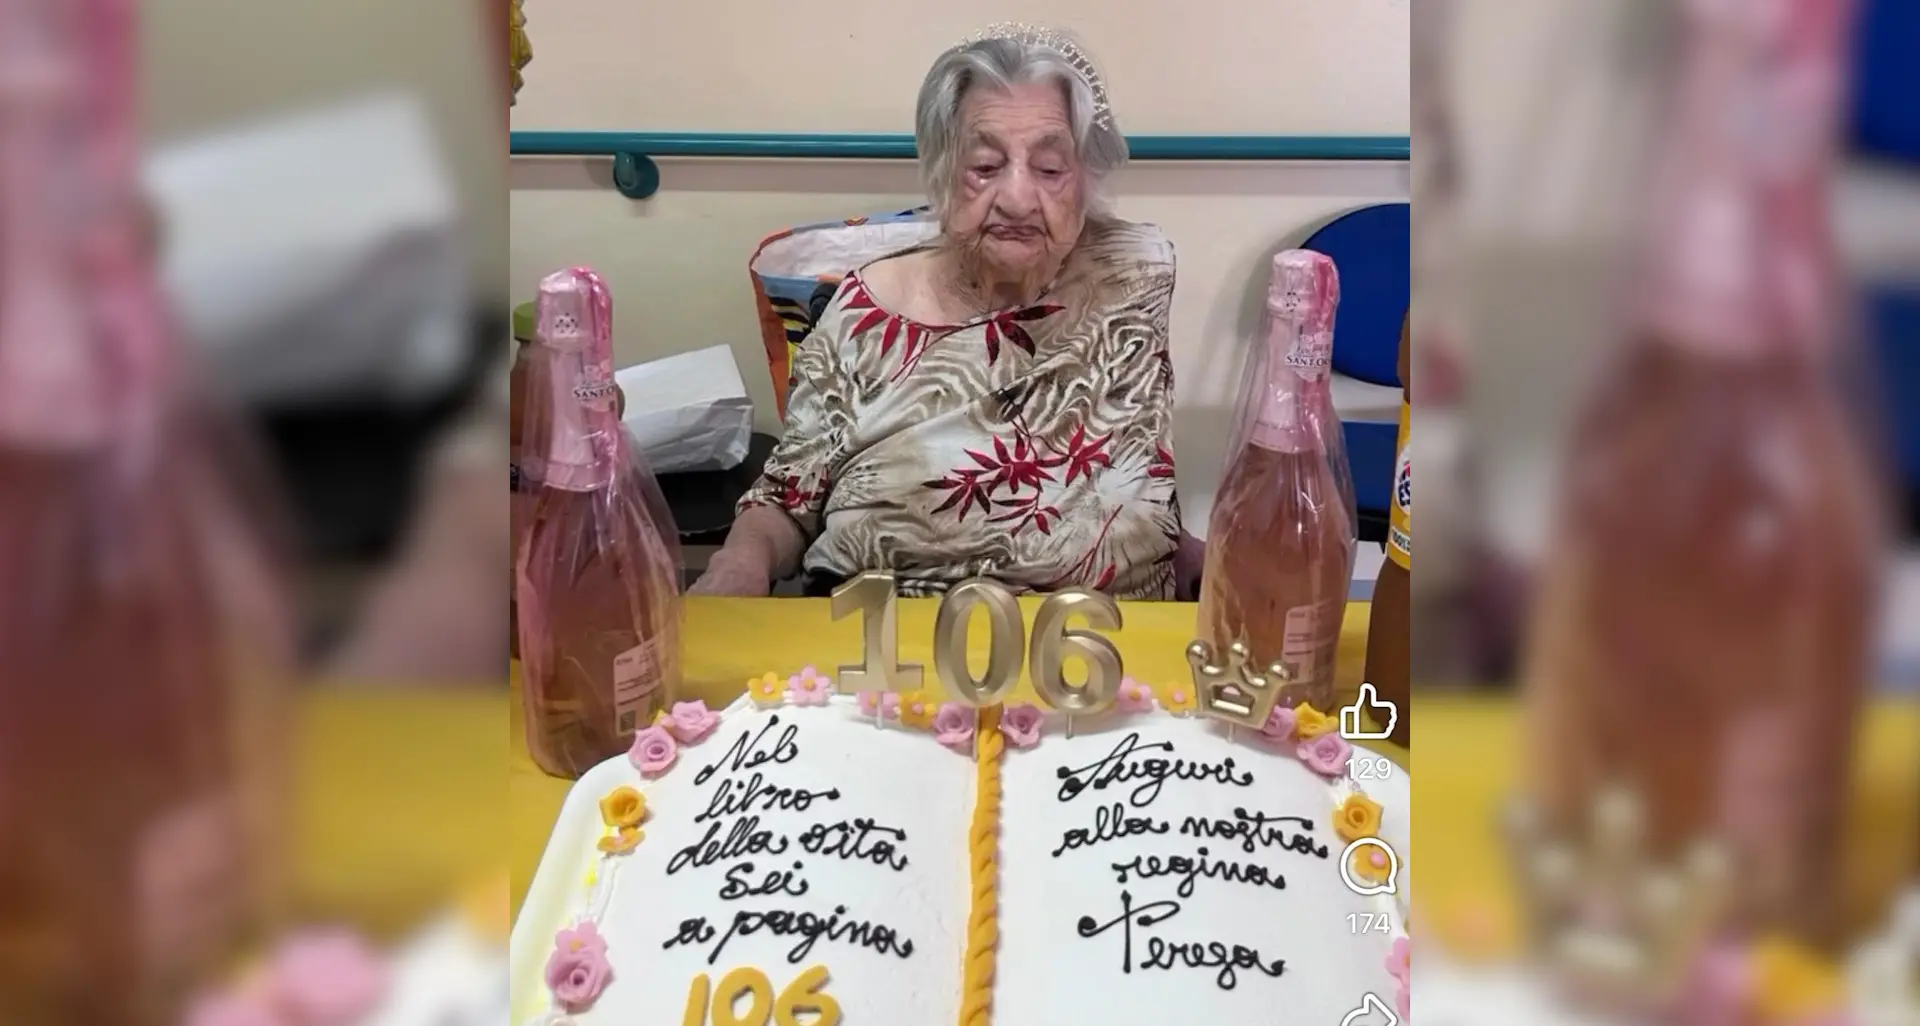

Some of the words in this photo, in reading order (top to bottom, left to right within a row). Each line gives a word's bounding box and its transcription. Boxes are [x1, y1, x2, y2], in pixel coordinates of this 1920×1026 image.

[830, 568, 1124, 714] 106
[693, 714, 799, 786] Nel
[1056, 732, 1254, 807] Auguri
[694, 772, 841, 823] libro
[666, 815, 789, 875] della
[799, 817, 908, 871] vita
[1052, 802, 1170, 857] alla
[1180, 806, 1329, 859] nostra
[719, 860, 809, 901] Sei
[1112, 846, 1286, 898] regina
[662, 916, 716, 950] a
[708, 904, 914, 965] pagina
[680, 964, 842, 1026] 106
